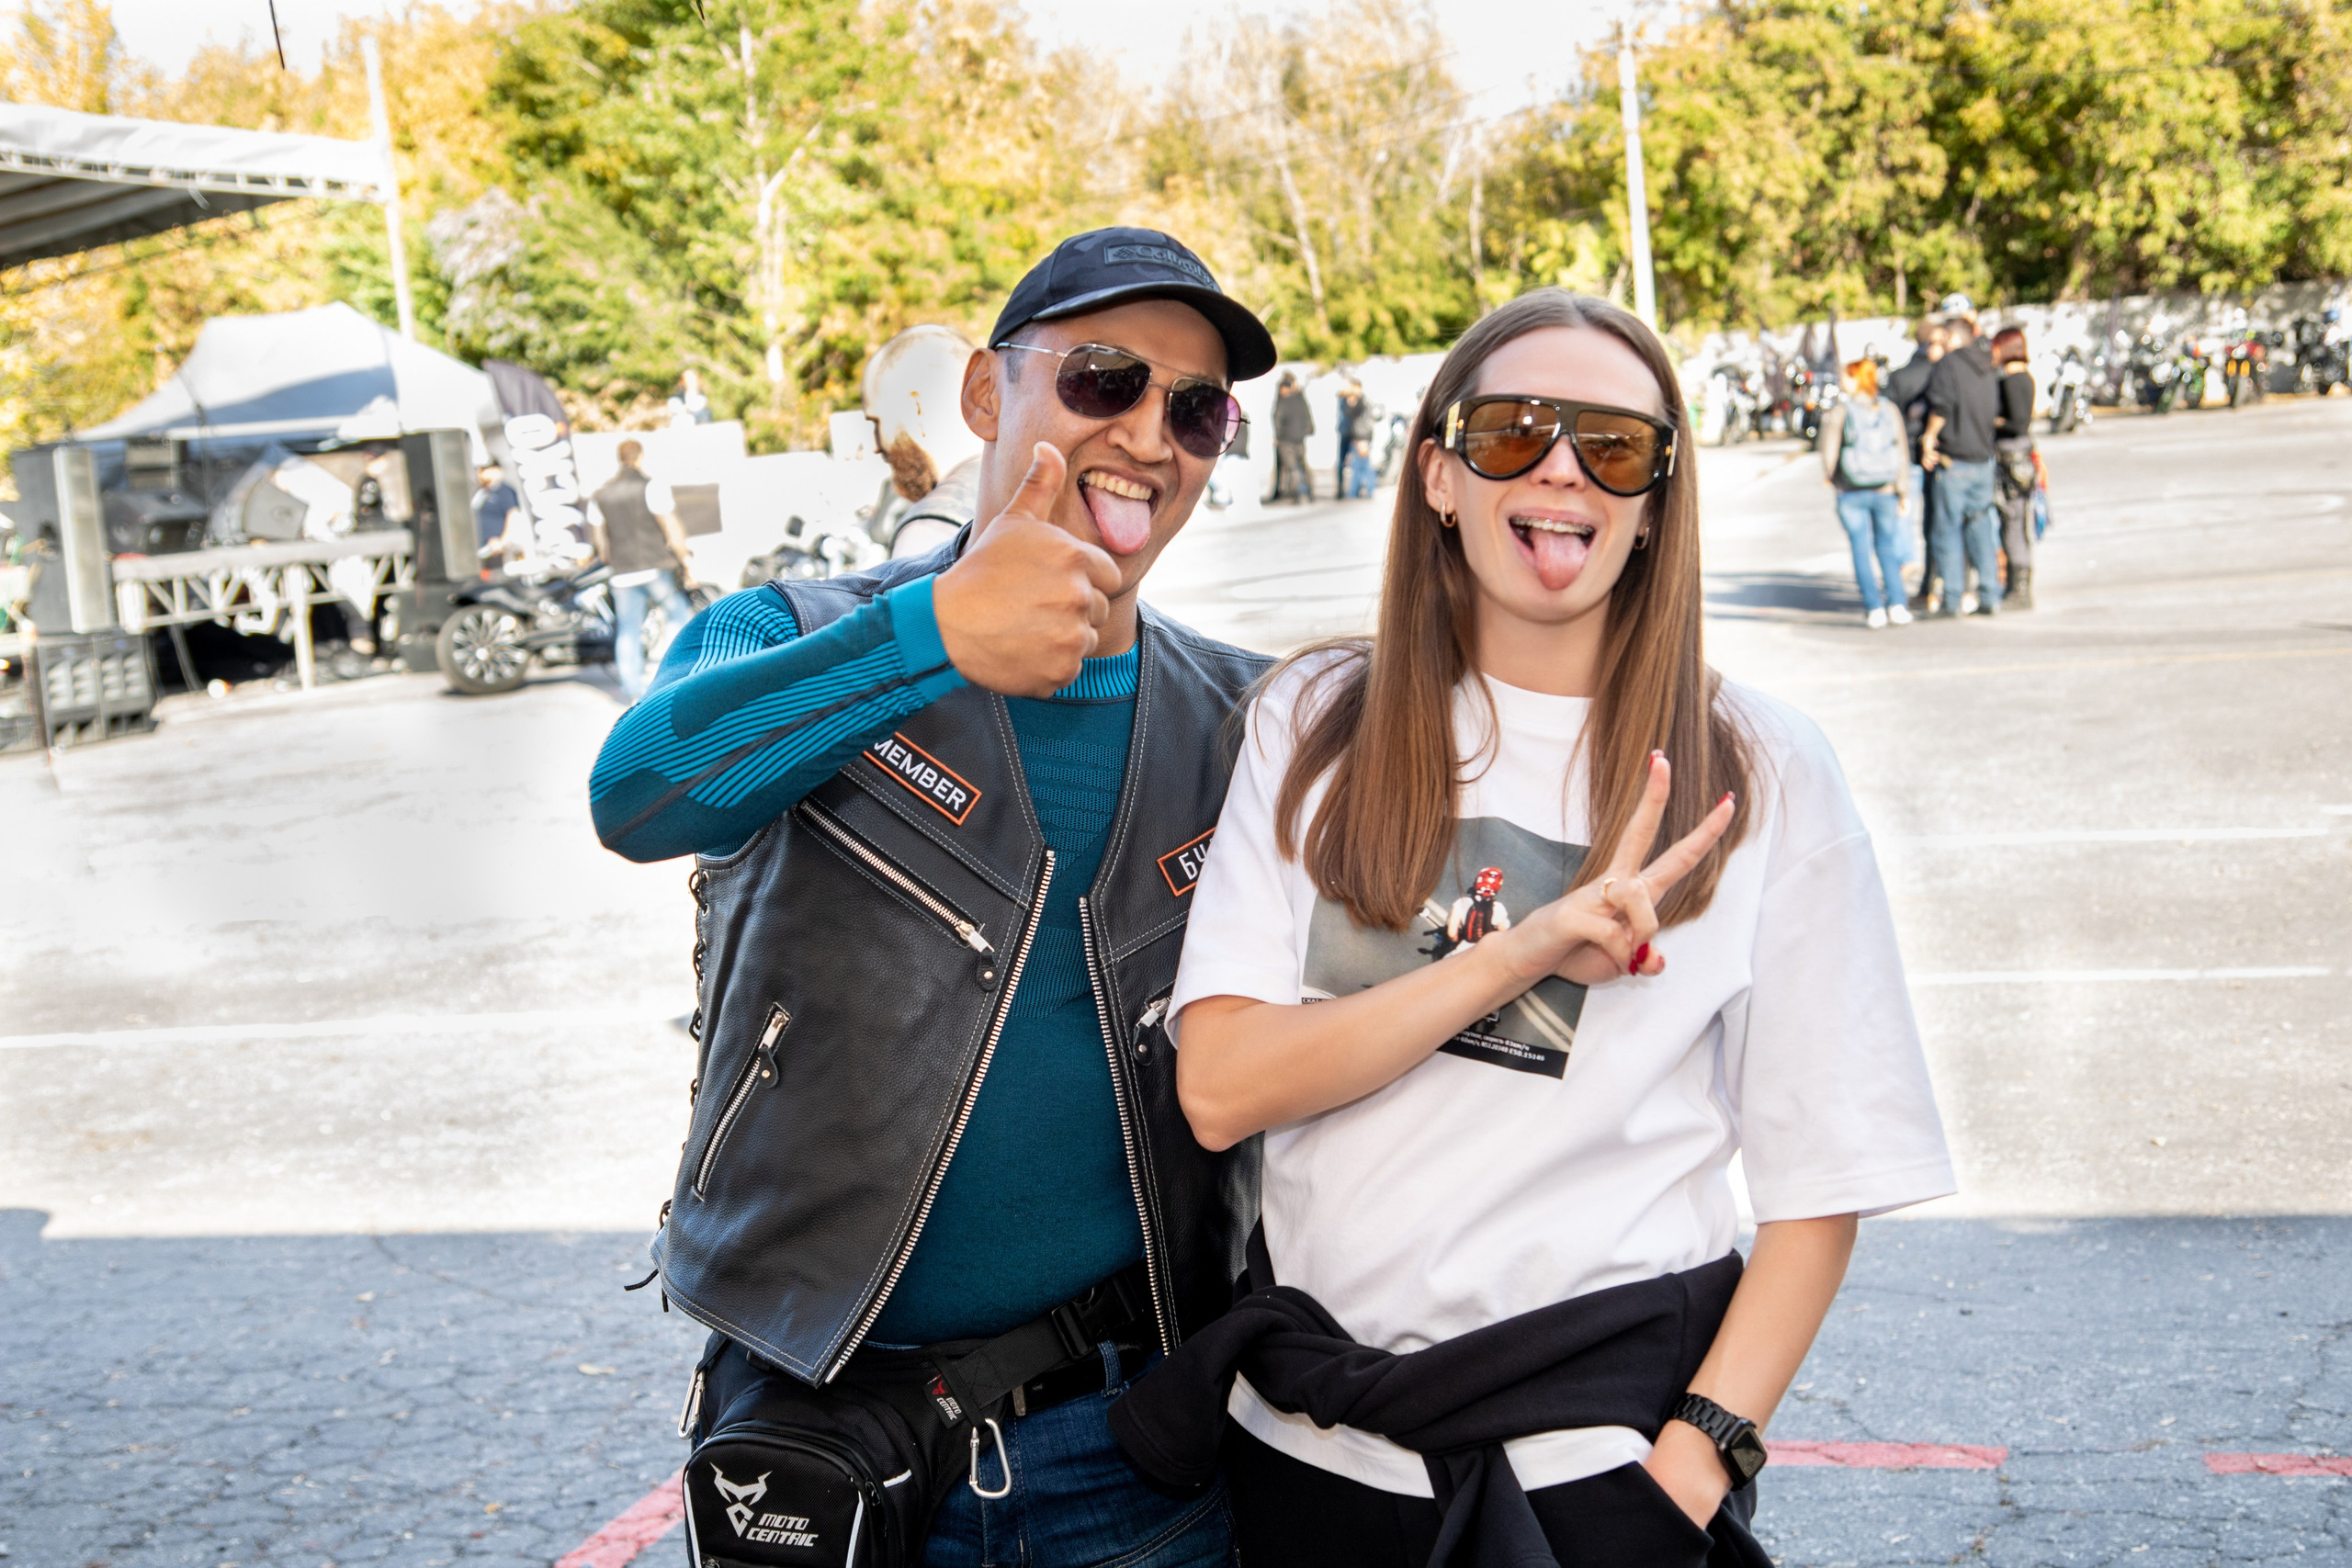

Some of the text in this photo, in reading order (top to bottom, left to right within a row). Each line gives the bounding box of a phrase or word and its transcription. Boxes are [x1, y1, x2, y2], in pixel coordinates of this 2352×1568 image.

[946, 1396, 962, 1415] MOTO
[758, 1513, 809, 1530] MOTO
[746, 1527, 819, 1547] CENTRIC
